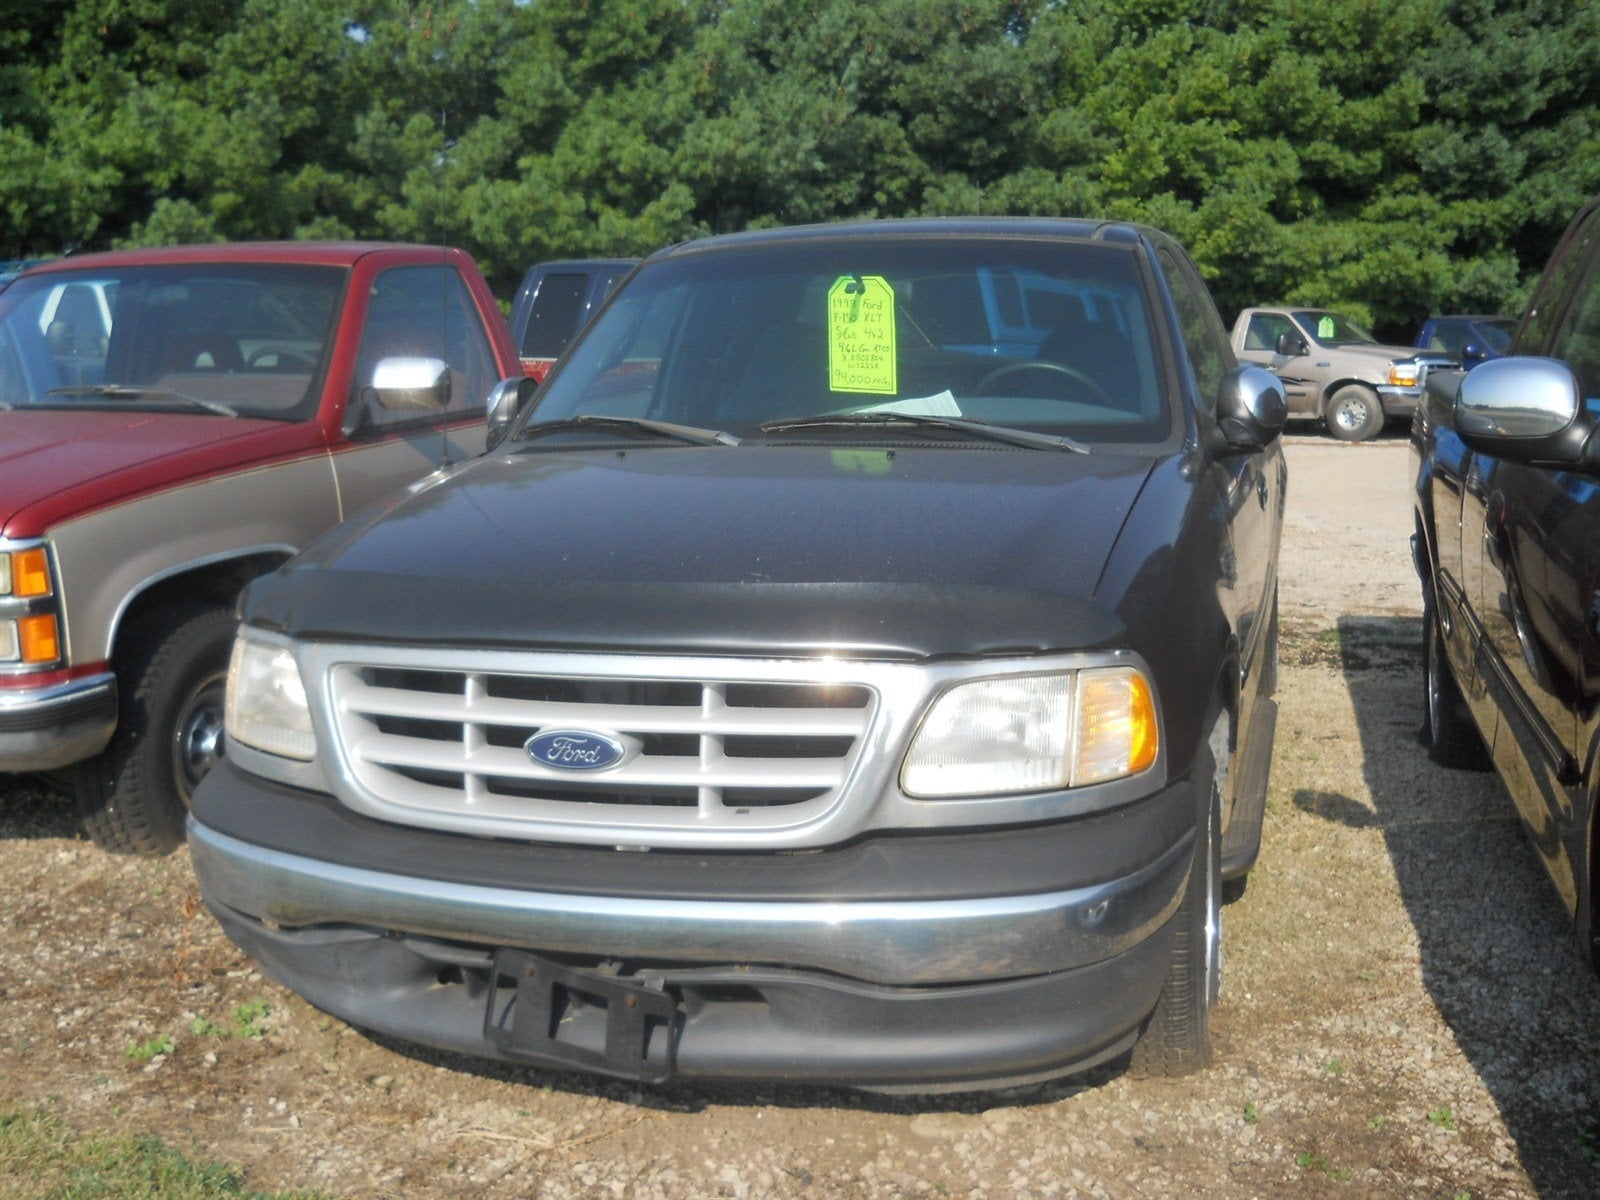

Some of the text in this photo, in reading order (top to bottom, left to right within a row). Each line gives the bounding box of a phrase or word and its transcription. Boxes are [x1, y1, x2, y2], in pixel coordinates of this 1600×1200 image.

[833, 299, 882, 310] 1999 Ford
[864, 312, 883, 322] XLT
[864, 327, 884, 339] 4x2
[547, 736, 600, 763] Ford
